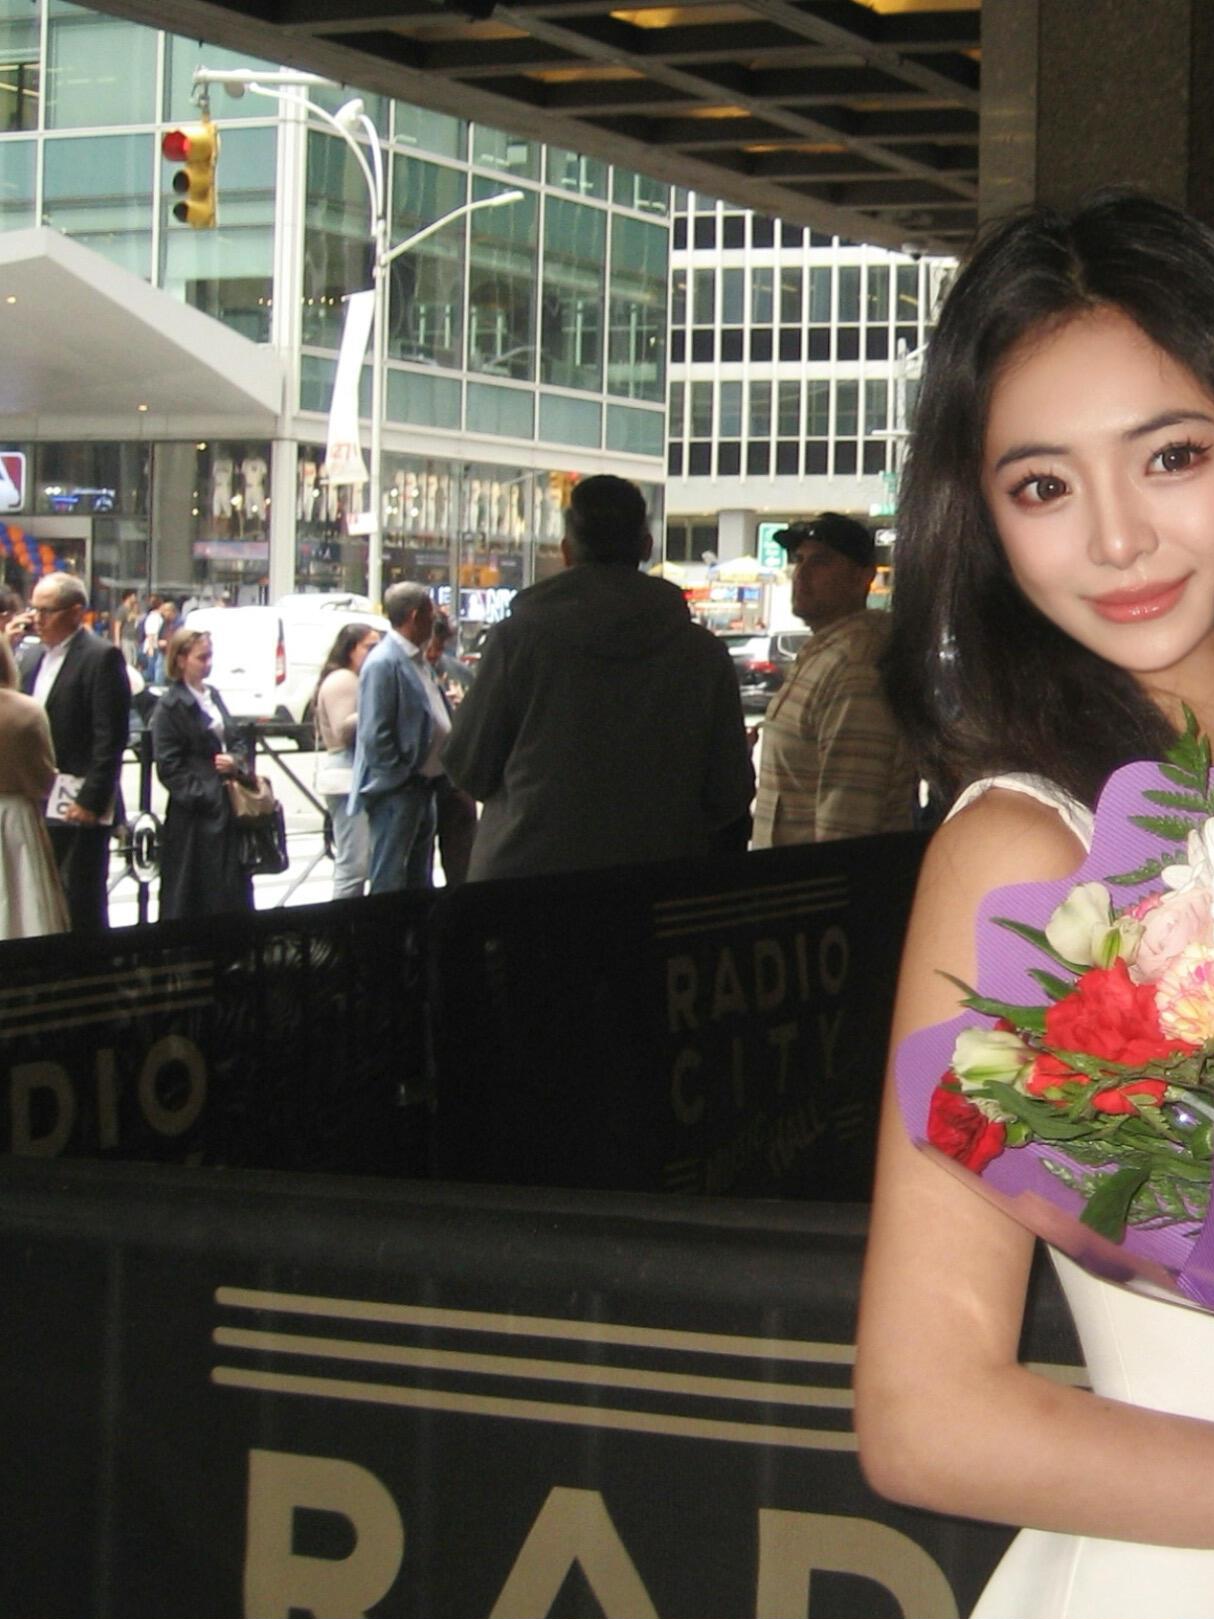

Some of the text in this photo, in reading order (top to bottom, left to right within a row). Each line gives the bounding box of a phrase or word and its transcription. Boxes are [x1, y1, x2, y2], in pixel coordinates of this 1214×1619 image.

[666, 924, 849, 1034] RADIO
[10, 1034, 208, 1157] DIO
[671, 1008, 844, 1125] CITY
[243, 1448, 959, 1619] RAD
